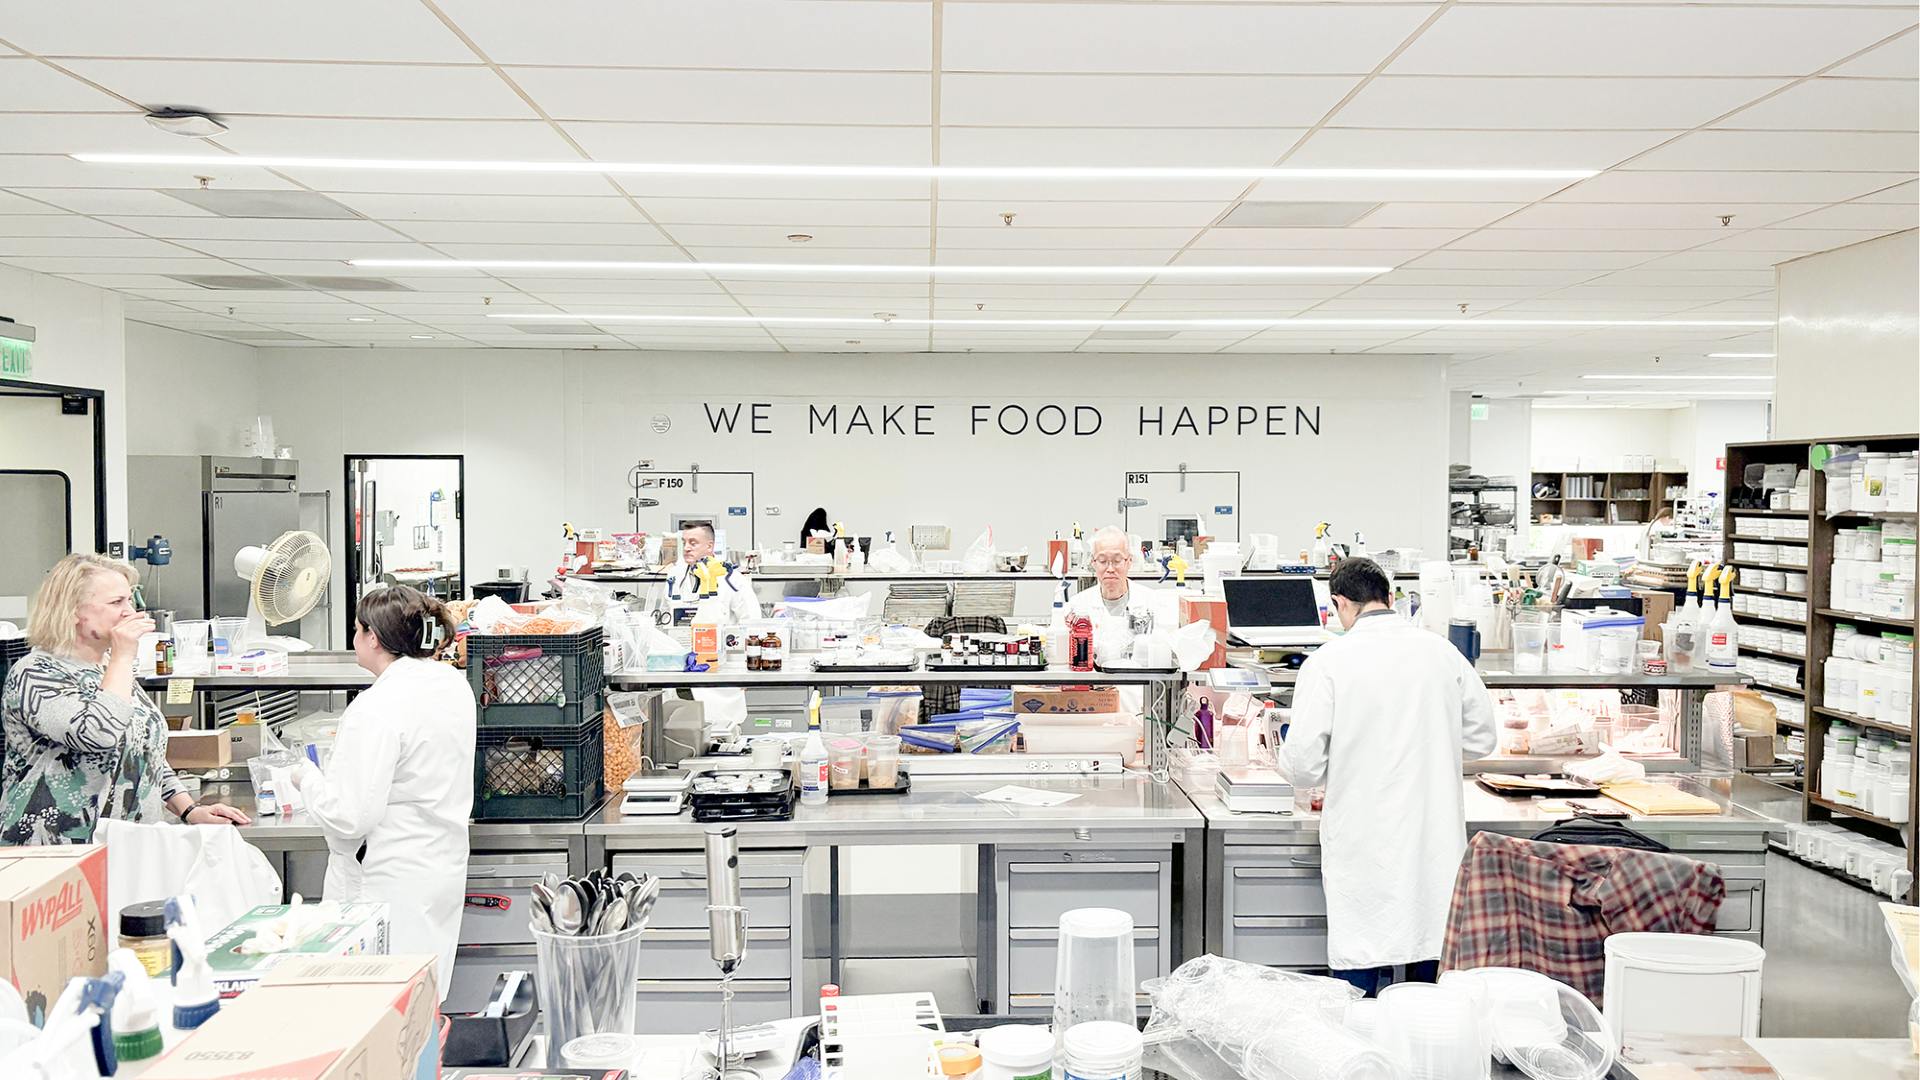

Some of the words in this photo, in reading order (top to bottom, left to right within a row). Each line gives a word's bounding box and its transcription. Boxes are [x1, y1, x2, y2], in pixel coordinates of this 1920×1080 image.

[2, 346, 26, 373] EXIT
[704, 402, 773, 434] WE
[809, 404, 935, 436] MAKE
[971, 404, 1102, 436] FOOD
[1139, 405, 1321, 436] HAPPEN
[659, 478, 684, 489] F150
[1128, 474, 1148, 484] R151
